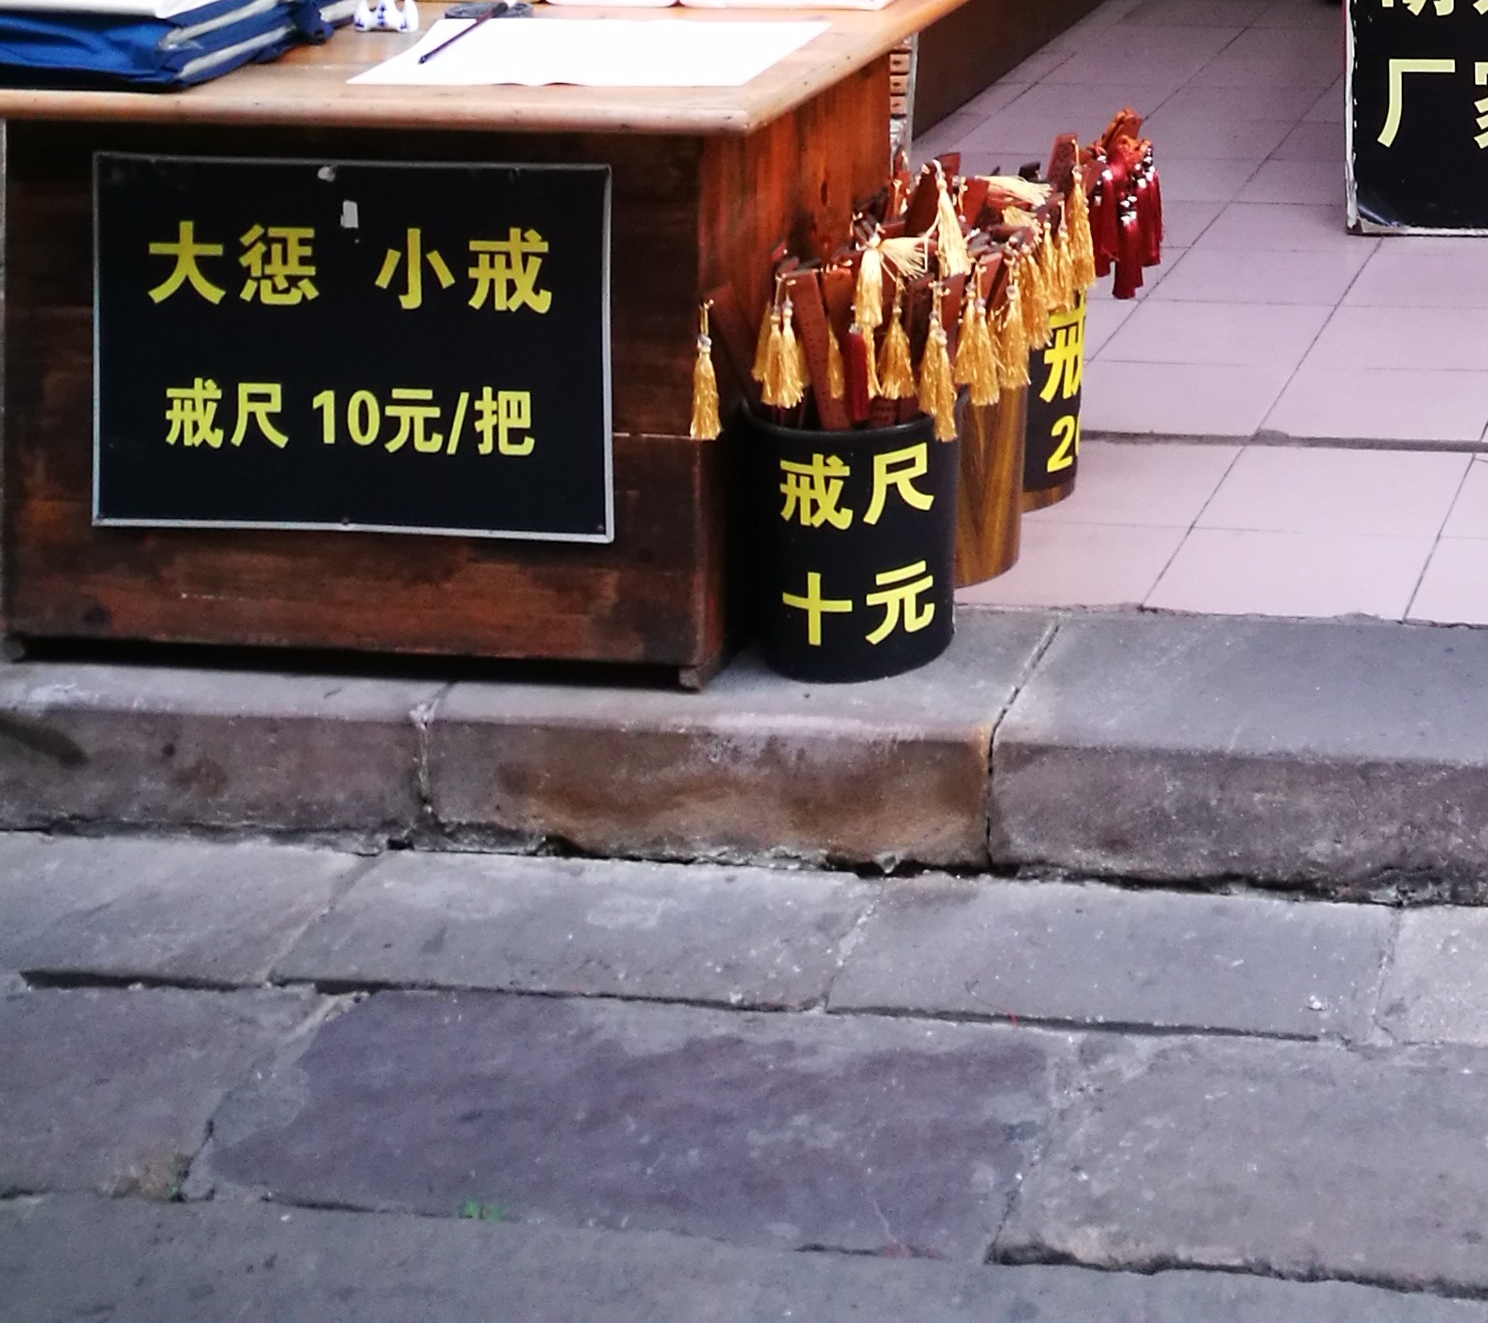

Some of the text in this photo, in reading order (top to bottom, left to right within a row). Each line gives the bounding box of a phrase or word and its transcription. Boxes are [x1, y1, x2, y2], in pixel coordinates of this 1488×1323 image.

[779, 442, 935, 530] 戒尺
[1047, 415, 1081, 473] 2
[782, 560, 936, 646] 十元
